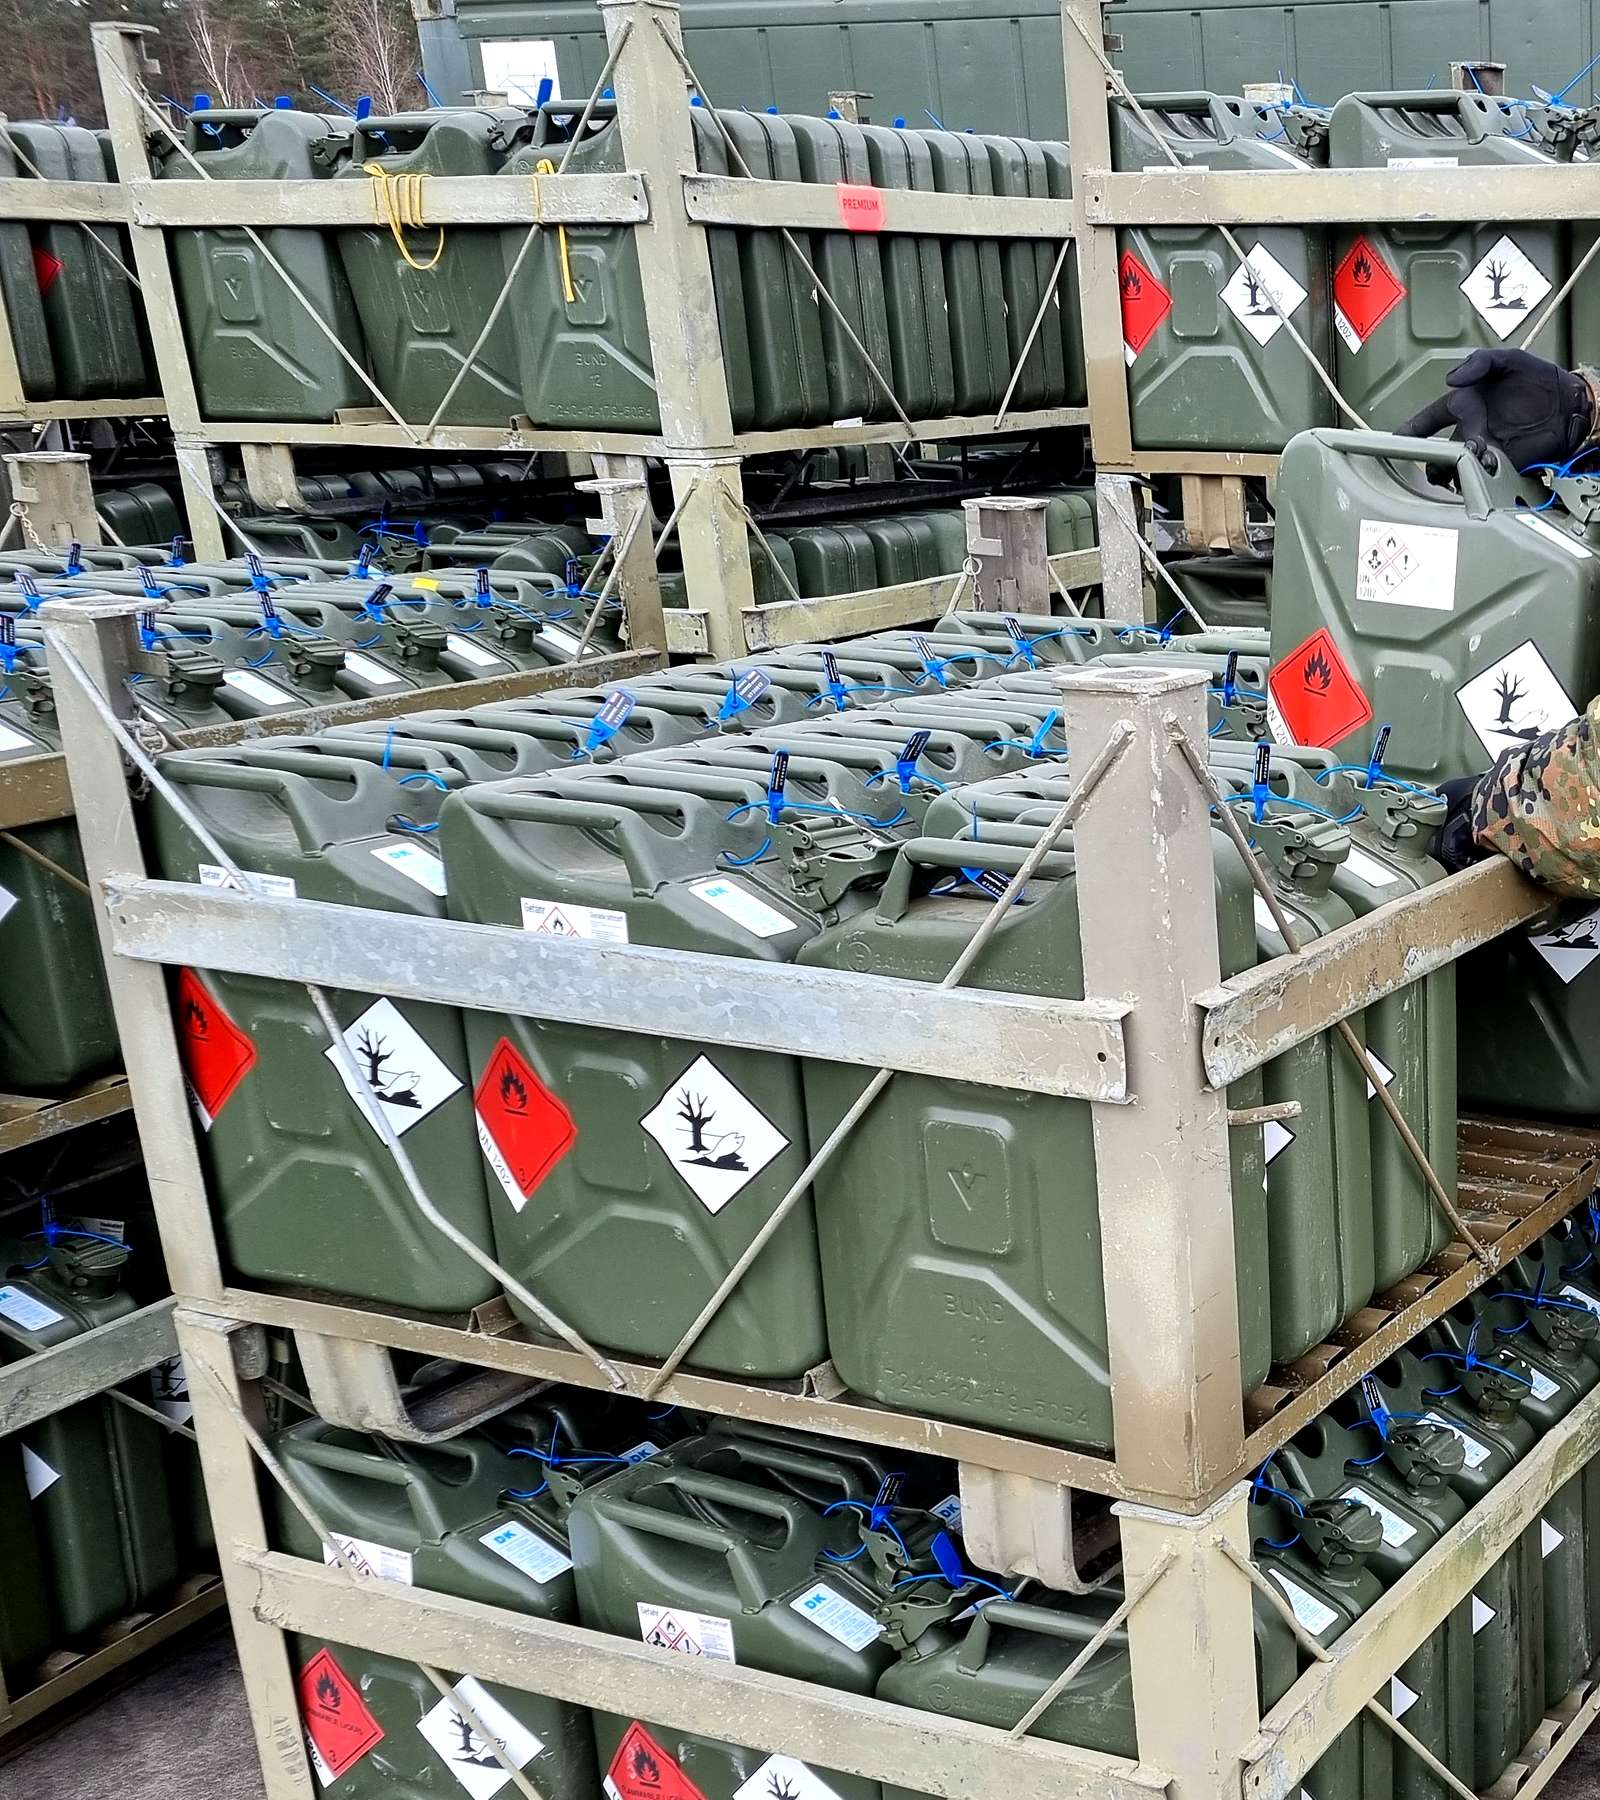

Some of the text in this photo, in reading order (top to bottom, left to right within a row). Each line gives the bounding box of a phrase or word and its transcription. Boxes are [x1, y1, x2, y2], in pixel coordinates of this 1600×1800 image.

[842, 198, 879, 212] PREMIUM
[1336, 316, 1352, 341] 1202
[575, 352, 607, 367] BUND
[1274, 724, 1291, 746] 120
[480, 1127, 511, 1188] UN 1202
[944, 1292, 1005, 1325] BUND
[630, 1448, 649, 1463] DK
[939, 1501, 960, 1519] DK
[493, 1530, 517, 1544] DK
[803, 1593, 827, 1610] DK
